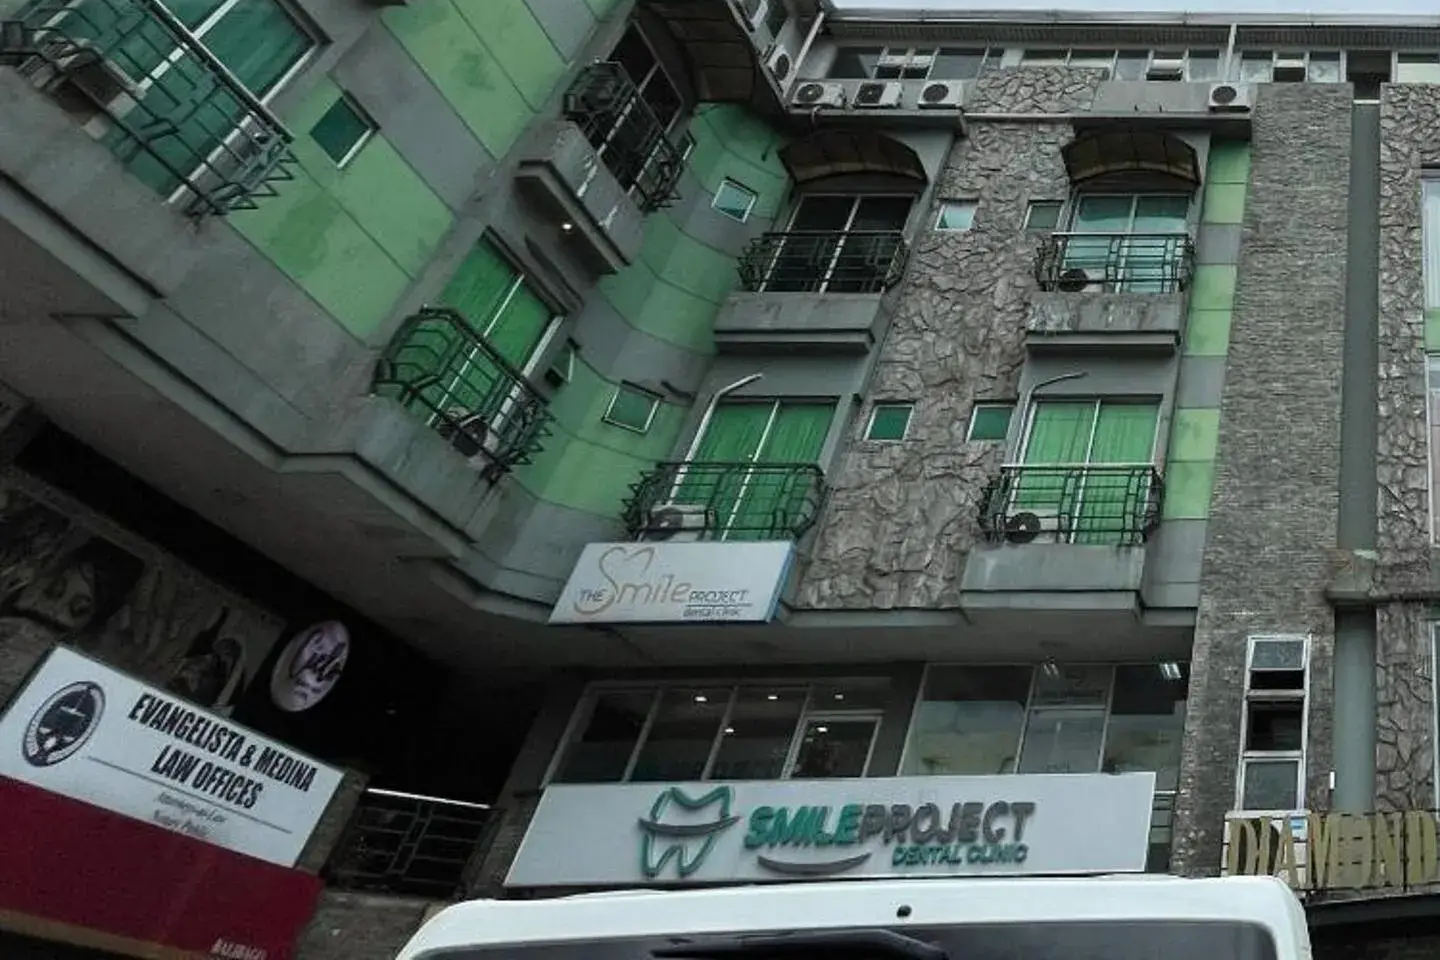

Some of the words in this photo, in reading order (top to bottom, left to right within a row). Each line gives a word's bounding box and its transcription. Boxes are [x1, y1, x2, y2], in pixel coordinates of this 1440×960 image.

[573, 546, 691, 615] Smile
[578, 589, 606, 603] THE
[688, 590, 749, 603] PROJECT
[128, 693, 246, 763] EVANGELISTA
[239, 744, 256, 767] &
[253, 746, 318, 792] MEDINA
[151, 745, 200, 784] LAW
[193, 761, 264, 809] OFFICES
[892, 844, 963, 867] DENTAL
[966, 843, 1029, 865] CLINIC
